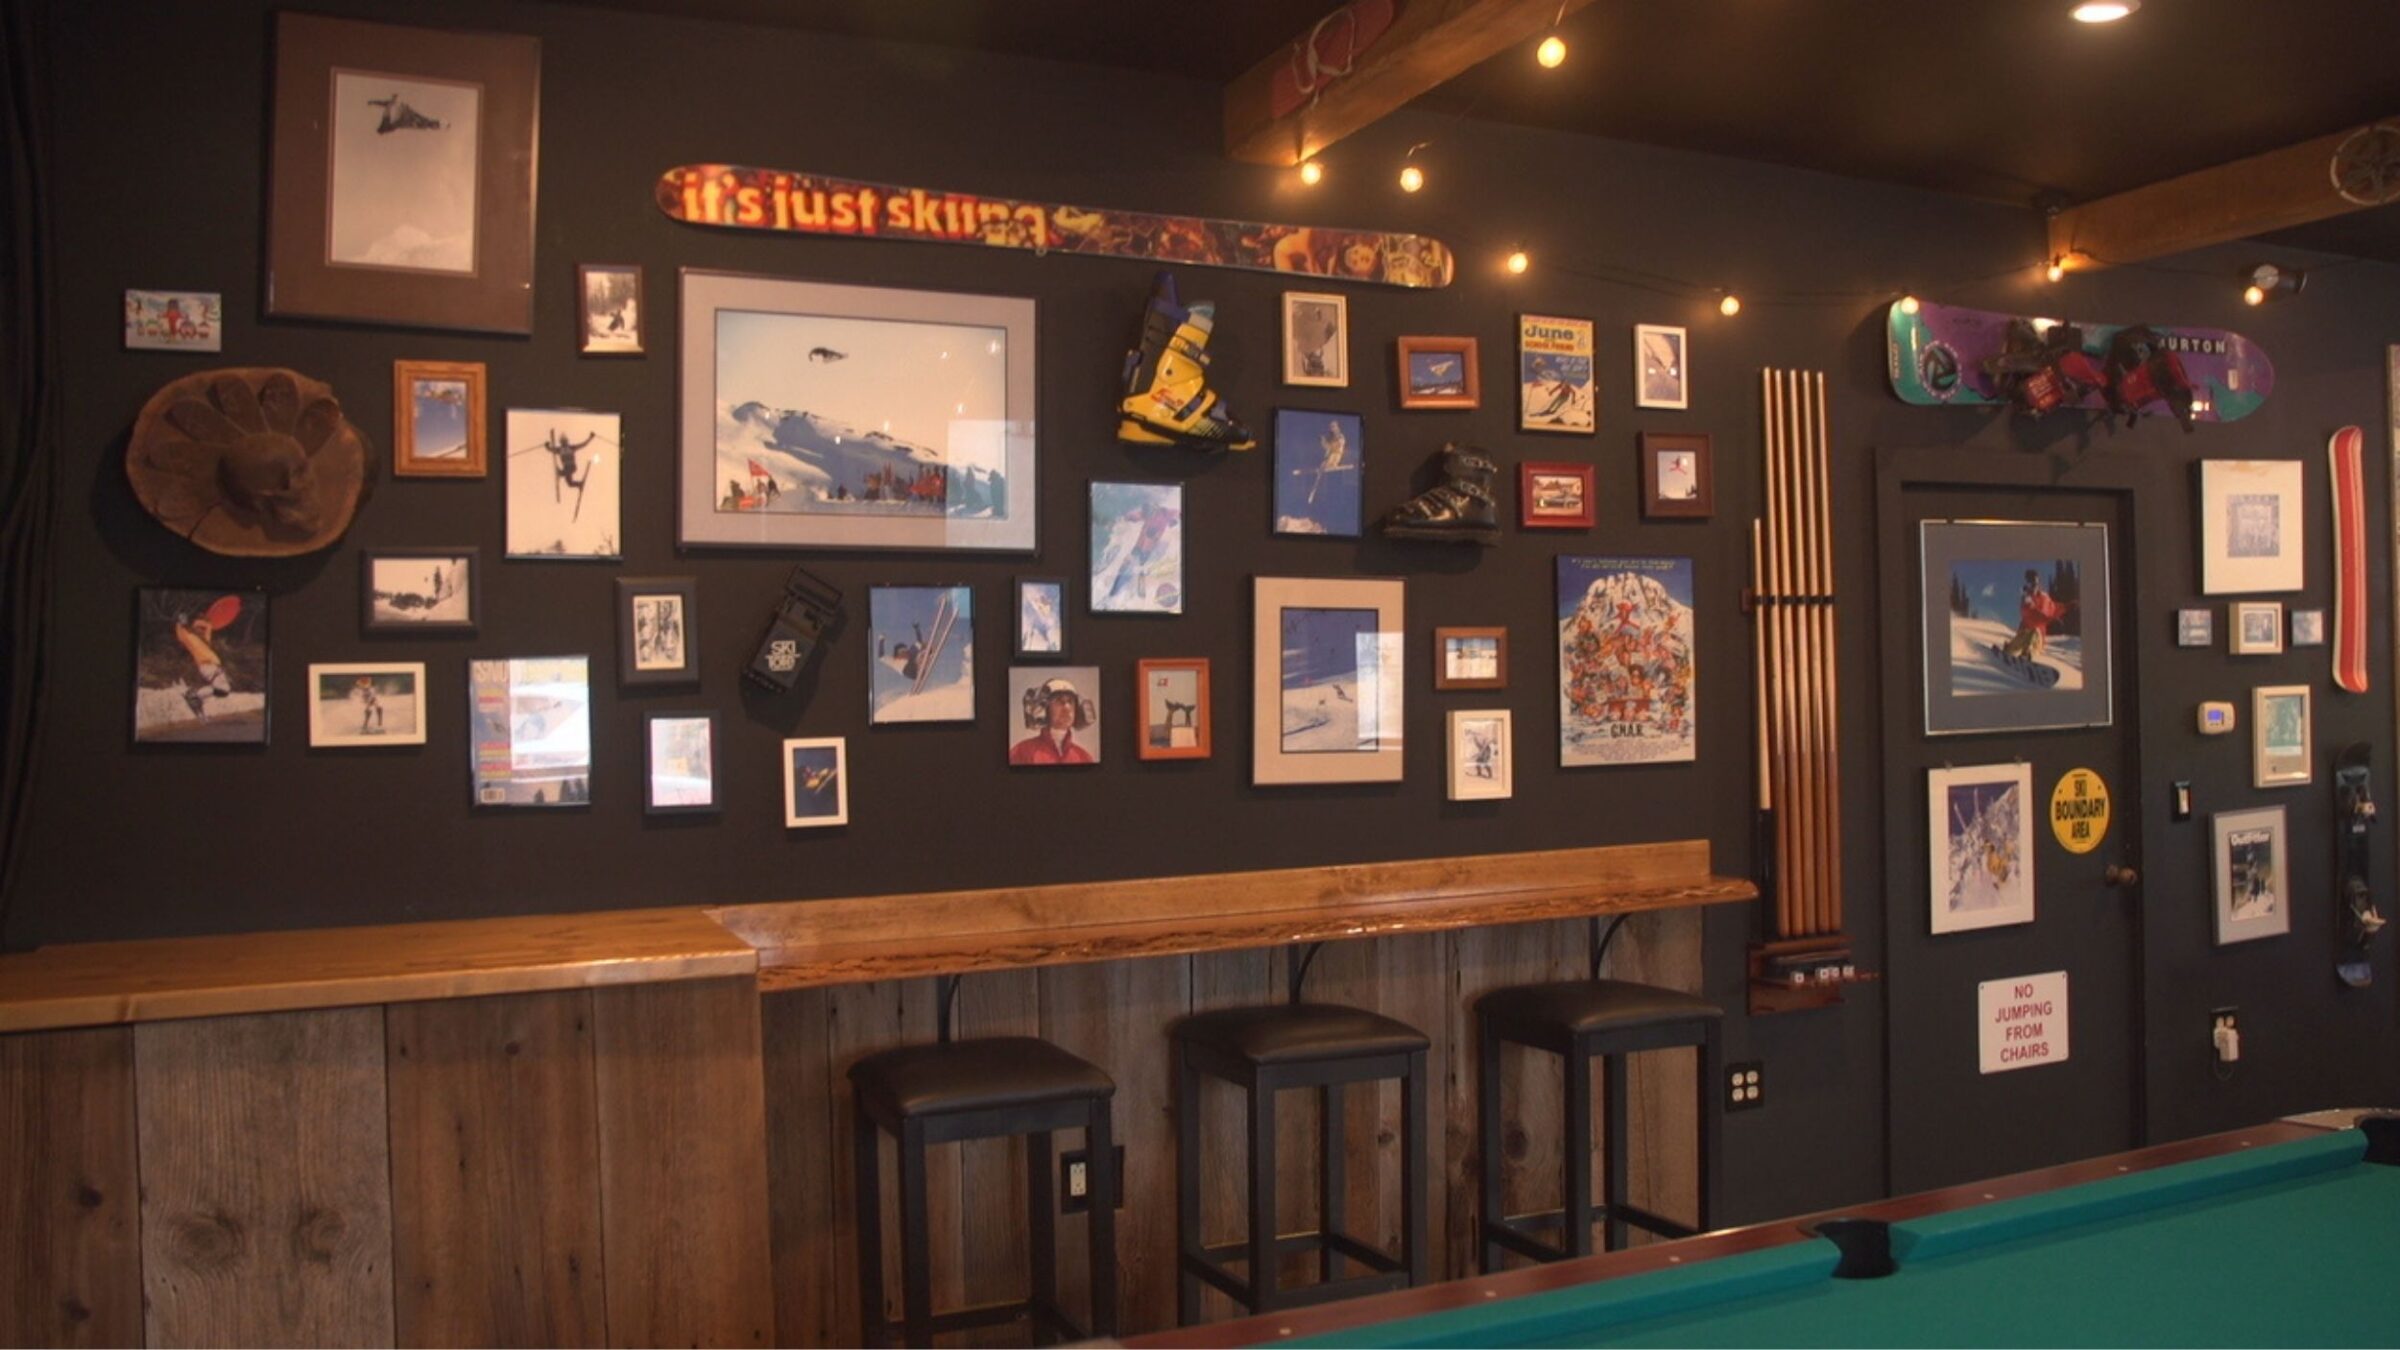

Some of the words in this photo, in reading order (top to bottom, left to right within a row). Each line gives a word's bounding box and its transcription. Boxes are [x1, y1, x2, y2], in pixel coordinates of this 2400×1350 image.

[683, 172, 764, 223] it's
[772, 174, 876, 231] just
[1524, 325, 1574, 340] June
[770, 640, 796, 656] SKI
[2074, 779, 2087, 797] SKI
[2055, 798, 2105, 820] BOUNDARY
[2071, 821, 2090, 839] AREA
[2014, 983, 2033, 999] NO
[1995, 1001, 2053, 1023] JUMPING
[2005, 1022, 2043, 1041] FROM
[2000, 1042, 2050, 1063] CHAIRS
